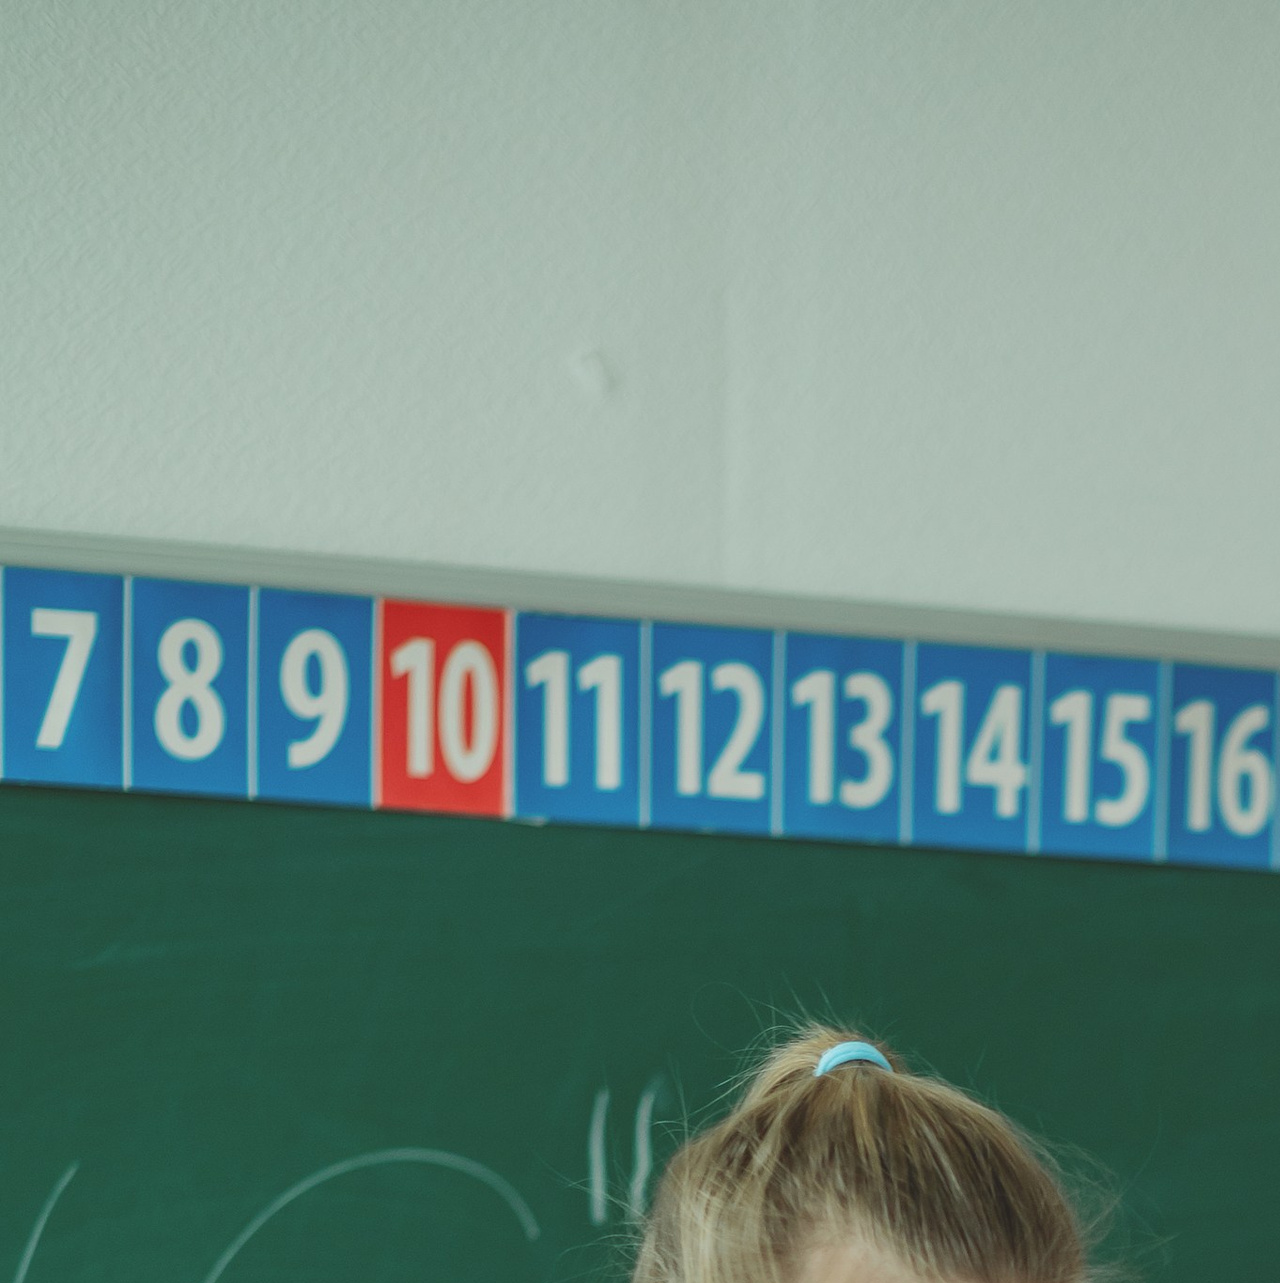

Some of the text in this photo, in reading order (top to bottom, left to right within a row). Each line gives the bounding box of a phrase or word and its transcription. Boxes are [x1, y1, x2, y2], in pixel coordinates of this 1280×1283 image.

[30, 607, 98, 749] 7
[154, 619, 225, 760] 8
[279, 628, 349, 769] 9
[390, 637, 500, 783] 10
[525, 651, 625, 791] 11
[658, 660, 766, 800] 12
[790, 670, 894, 809] 13
[921, 680, 1028, 818] 14
[1049, 690, 1152, 828] 15
[1174, 700, 1274, 837] 16
